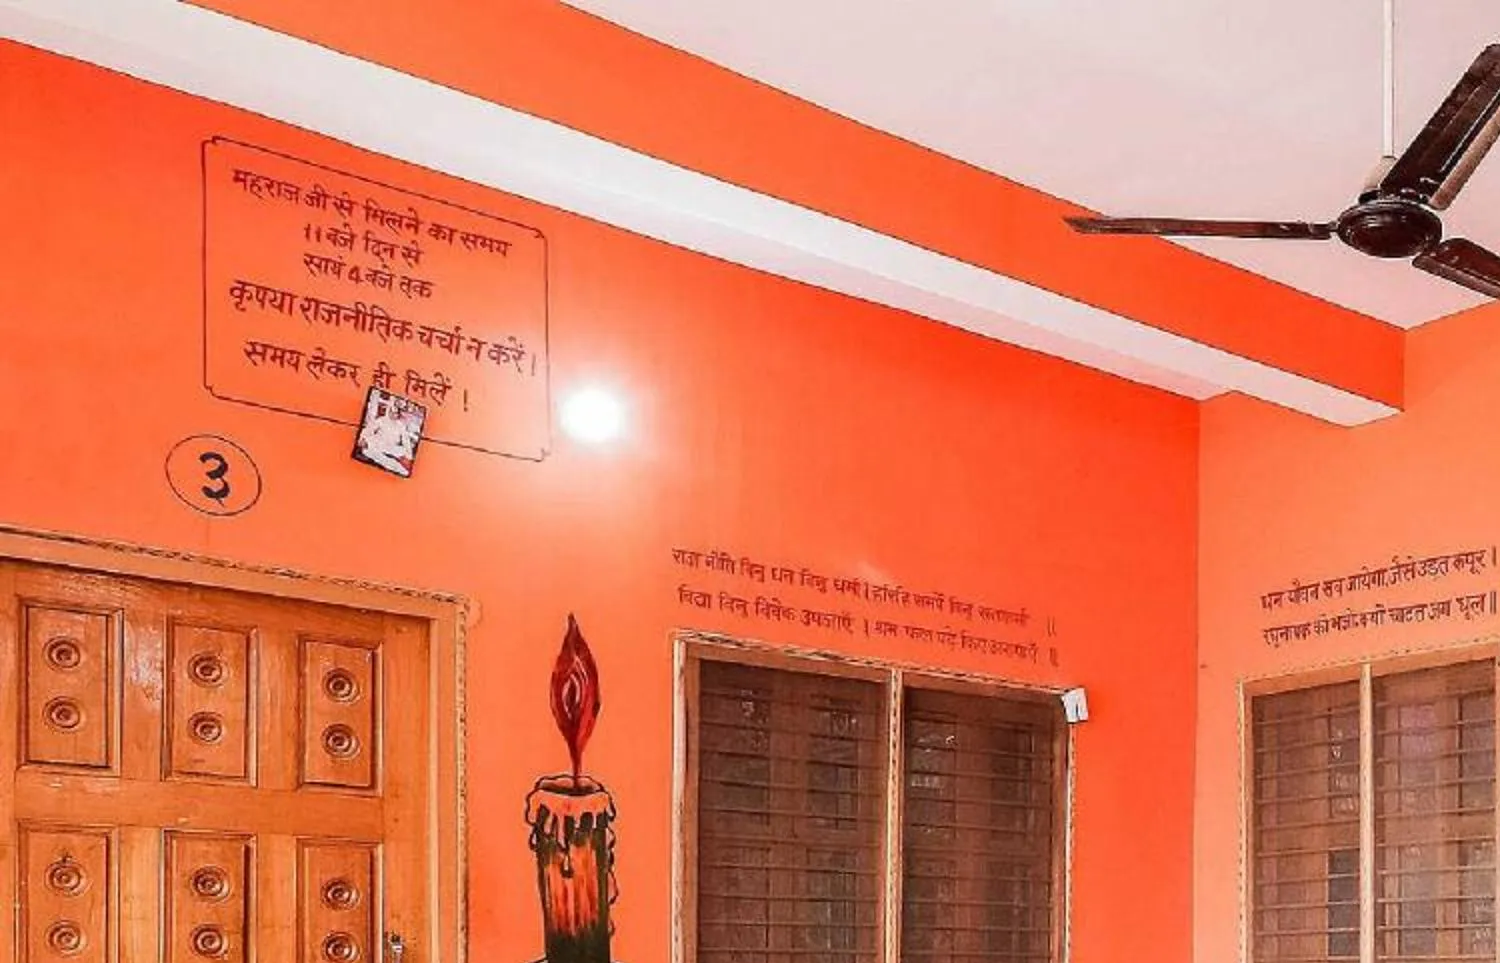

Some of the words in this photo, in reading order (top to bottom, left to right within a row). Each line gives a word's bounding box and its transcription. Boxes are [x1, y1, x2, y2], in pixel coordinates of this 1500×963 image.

[304, 184, 328, 211] जी
[333, 191, 356, 219] से
[363, 200, 422, 234] मिलने
[428, 223, 457, 246] का
[460, 232, 512, 257] समय
[363, 230, 399, 262] दिन
[402, 240, 424, 267] से
[399, 275, 436, 299] तक
[300, 296, 413, 343] राजनीतिक
[418, 326, 464, 356] चर्चा
[466, 337, 486, 360] न
[244, 340, 305, 372] समय
[306, 348, 361, 387] लेकर
[372, 361, 396, 388] ही
